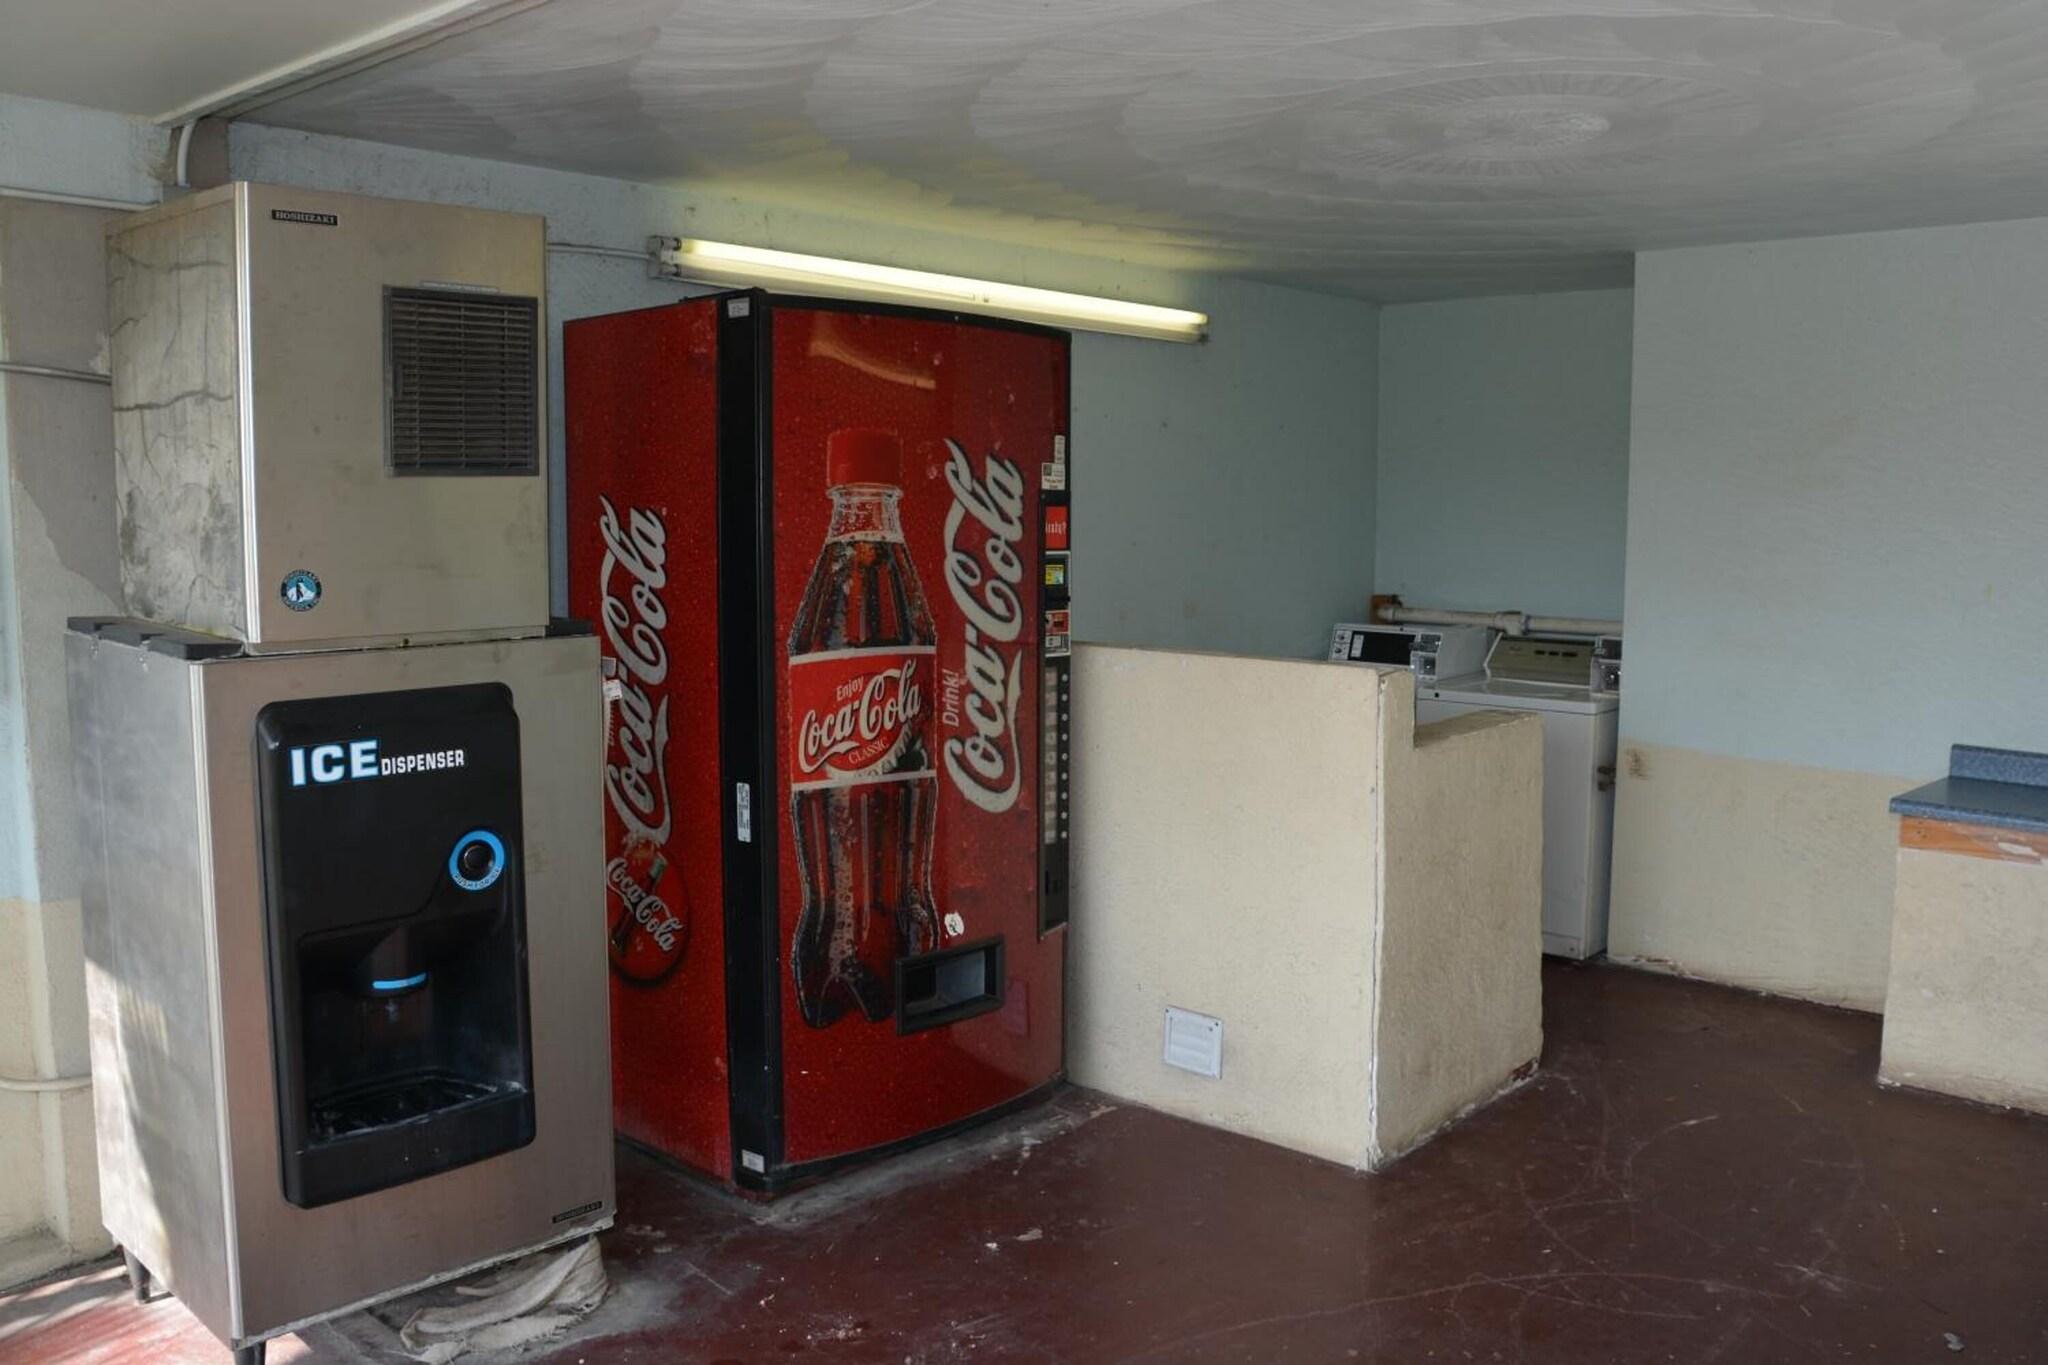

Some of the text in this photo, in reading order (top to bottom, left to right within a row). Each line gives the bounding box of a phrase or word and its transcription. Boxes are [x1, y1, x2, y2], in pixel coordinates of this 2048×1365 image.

[275, 211, 335, 224] HOSHIZAKI
[944, 438, 1023, 812] Coca-Cola
[600, 495, 671, 844] Coca-Cola
[836, 675, 865, 702] Enjoy
[943, 669, 960, 728] Drink!
[799, 657, 922, 774] Coca-Cola
[291, 740, 465, 786] ICE DISPENSER
[848, 736, 890, 765] CLASSIC
[606, 857, 684, 951] Coca-Cola
